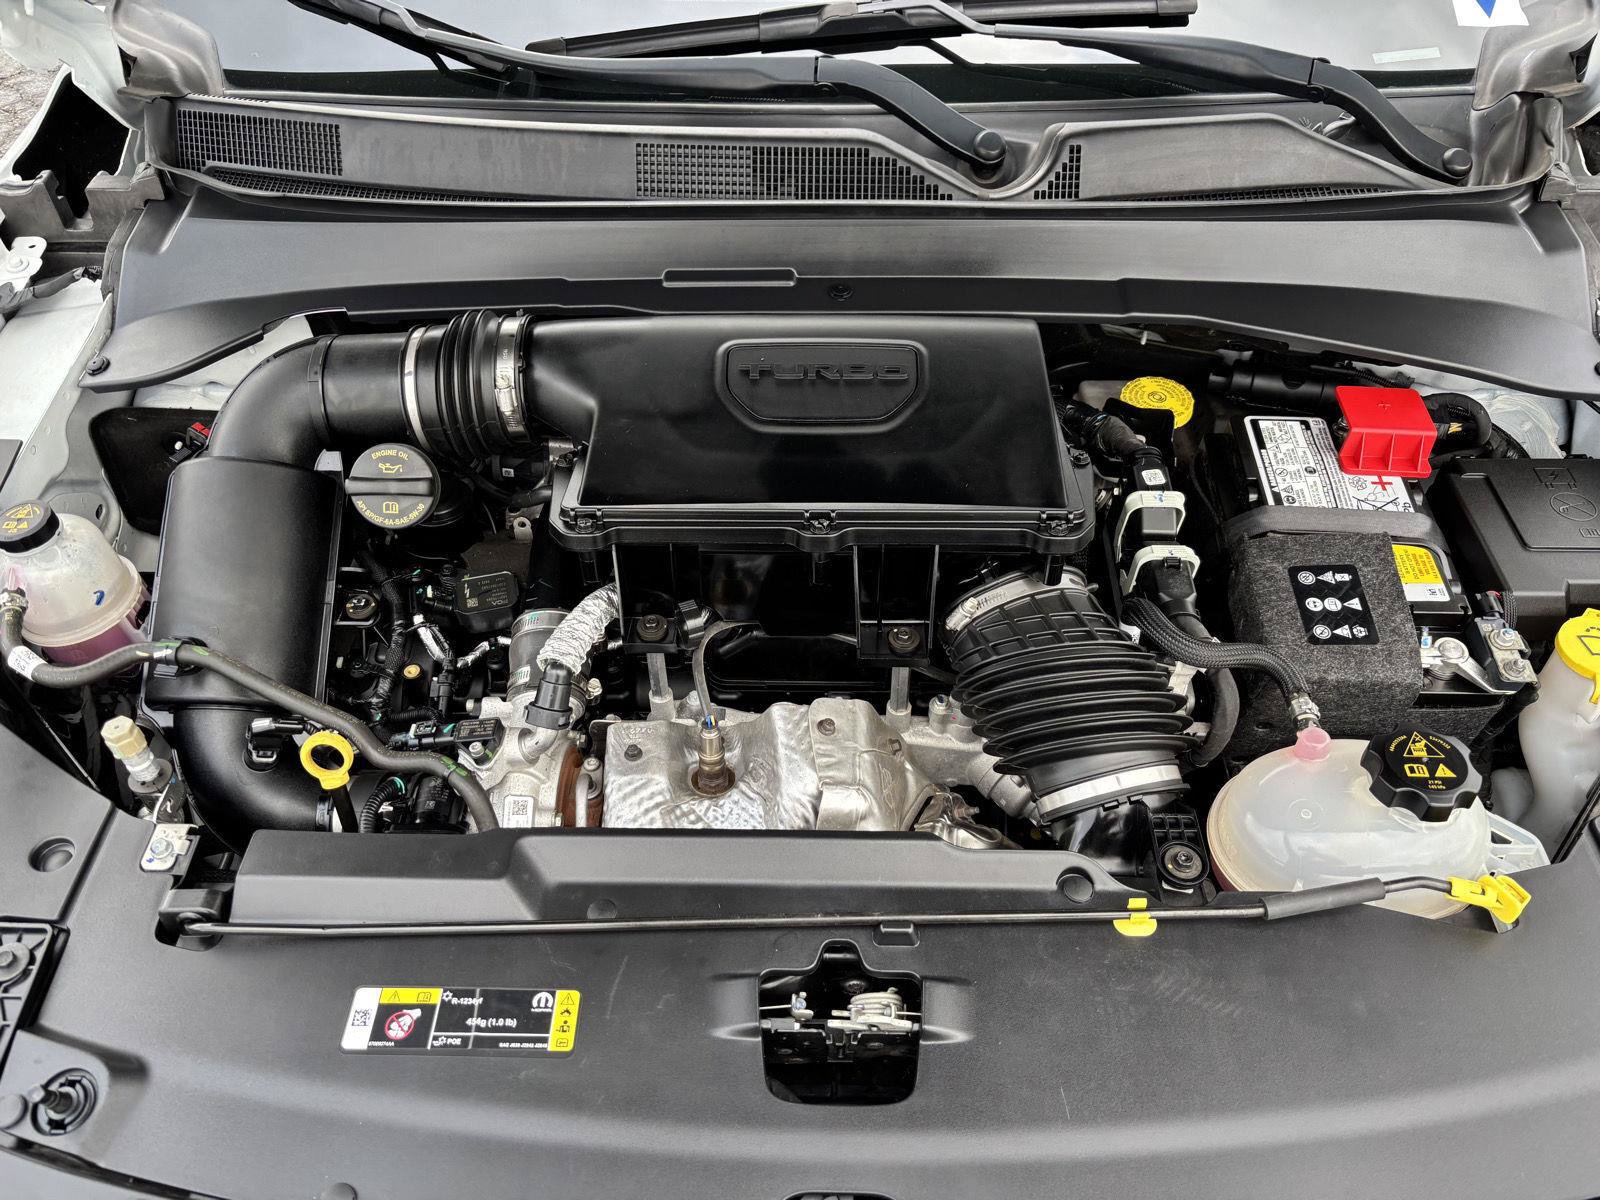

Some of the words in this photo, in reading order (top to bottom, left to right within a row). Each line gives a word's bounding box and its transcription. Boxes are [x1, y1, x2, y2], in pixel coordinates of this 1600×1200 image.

[738, 363, 910, 381] TURBO
[372, 449, 397, 460] ENGINE
[398, 451, 409, 460] OIL
[356, 500, 366, 511] API
[451, 997, 483, 1006] R-1234yf
[466, 1018, 487, 1027] 454g
[488, 1018, 502, 1027] (1.0
[505, 1018, 517, 1027] lb)
